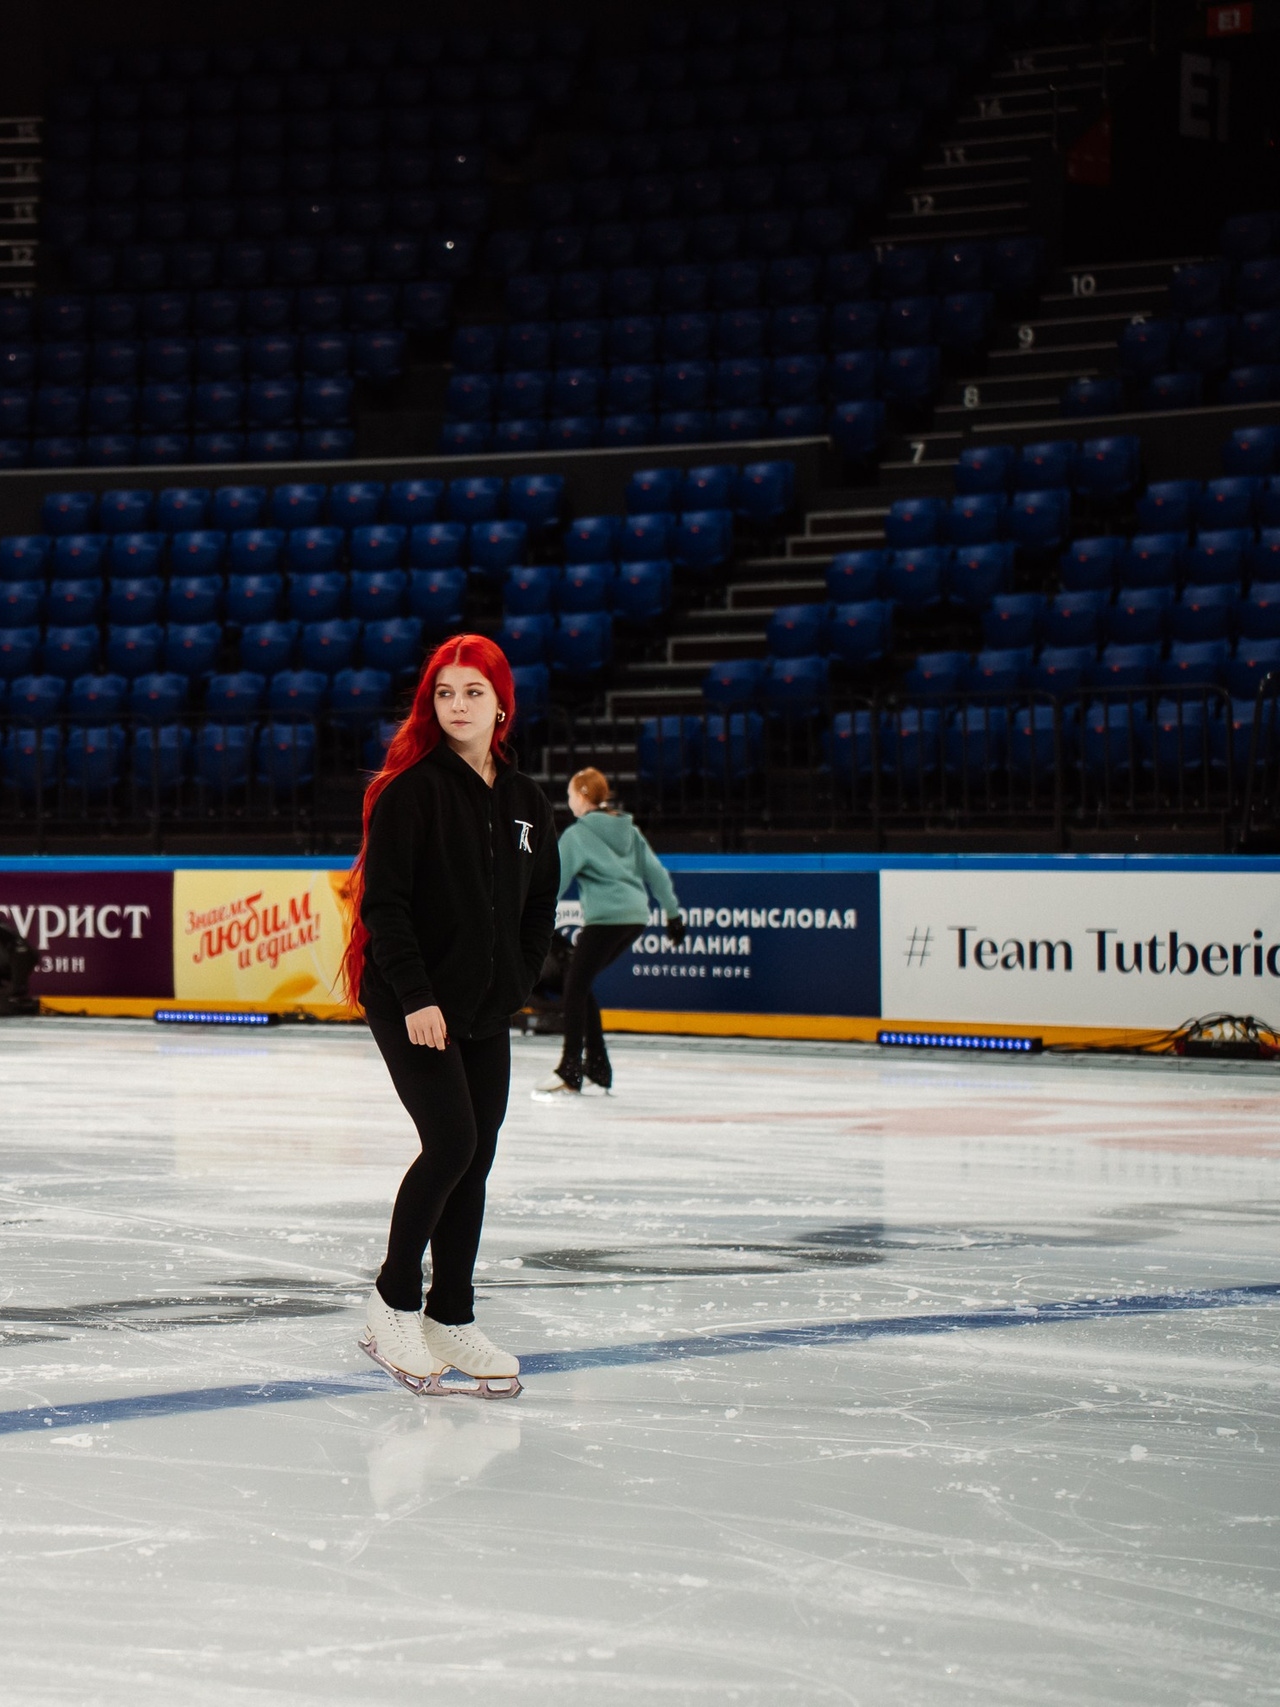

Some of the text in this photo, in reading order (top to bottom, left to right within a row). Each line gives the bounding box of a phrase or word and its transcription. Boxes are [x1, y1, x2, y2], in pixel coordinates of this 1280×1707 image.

[1218, 8, 1240, 31] E1
[1179, 51, 1232, 143] E1
[1071, 273, 1096, 297] 10
[1018, 325, 1035, 348] 9
[963, 385, 981, 409] 8
[910, 442, 926, 464] 7
[192, 889, 312, 964] любим
[646, 908, 858, 929] ЫПРОМЫСЛОВАЯ
[238, 913, 320, 970] и едим!
[632, 934, 751, 955] КОМПАНИЯ
[947, 925, 1073, 972] Team
[632, 964, 751, 979] ОХОТСКОЕ МОРЕ
